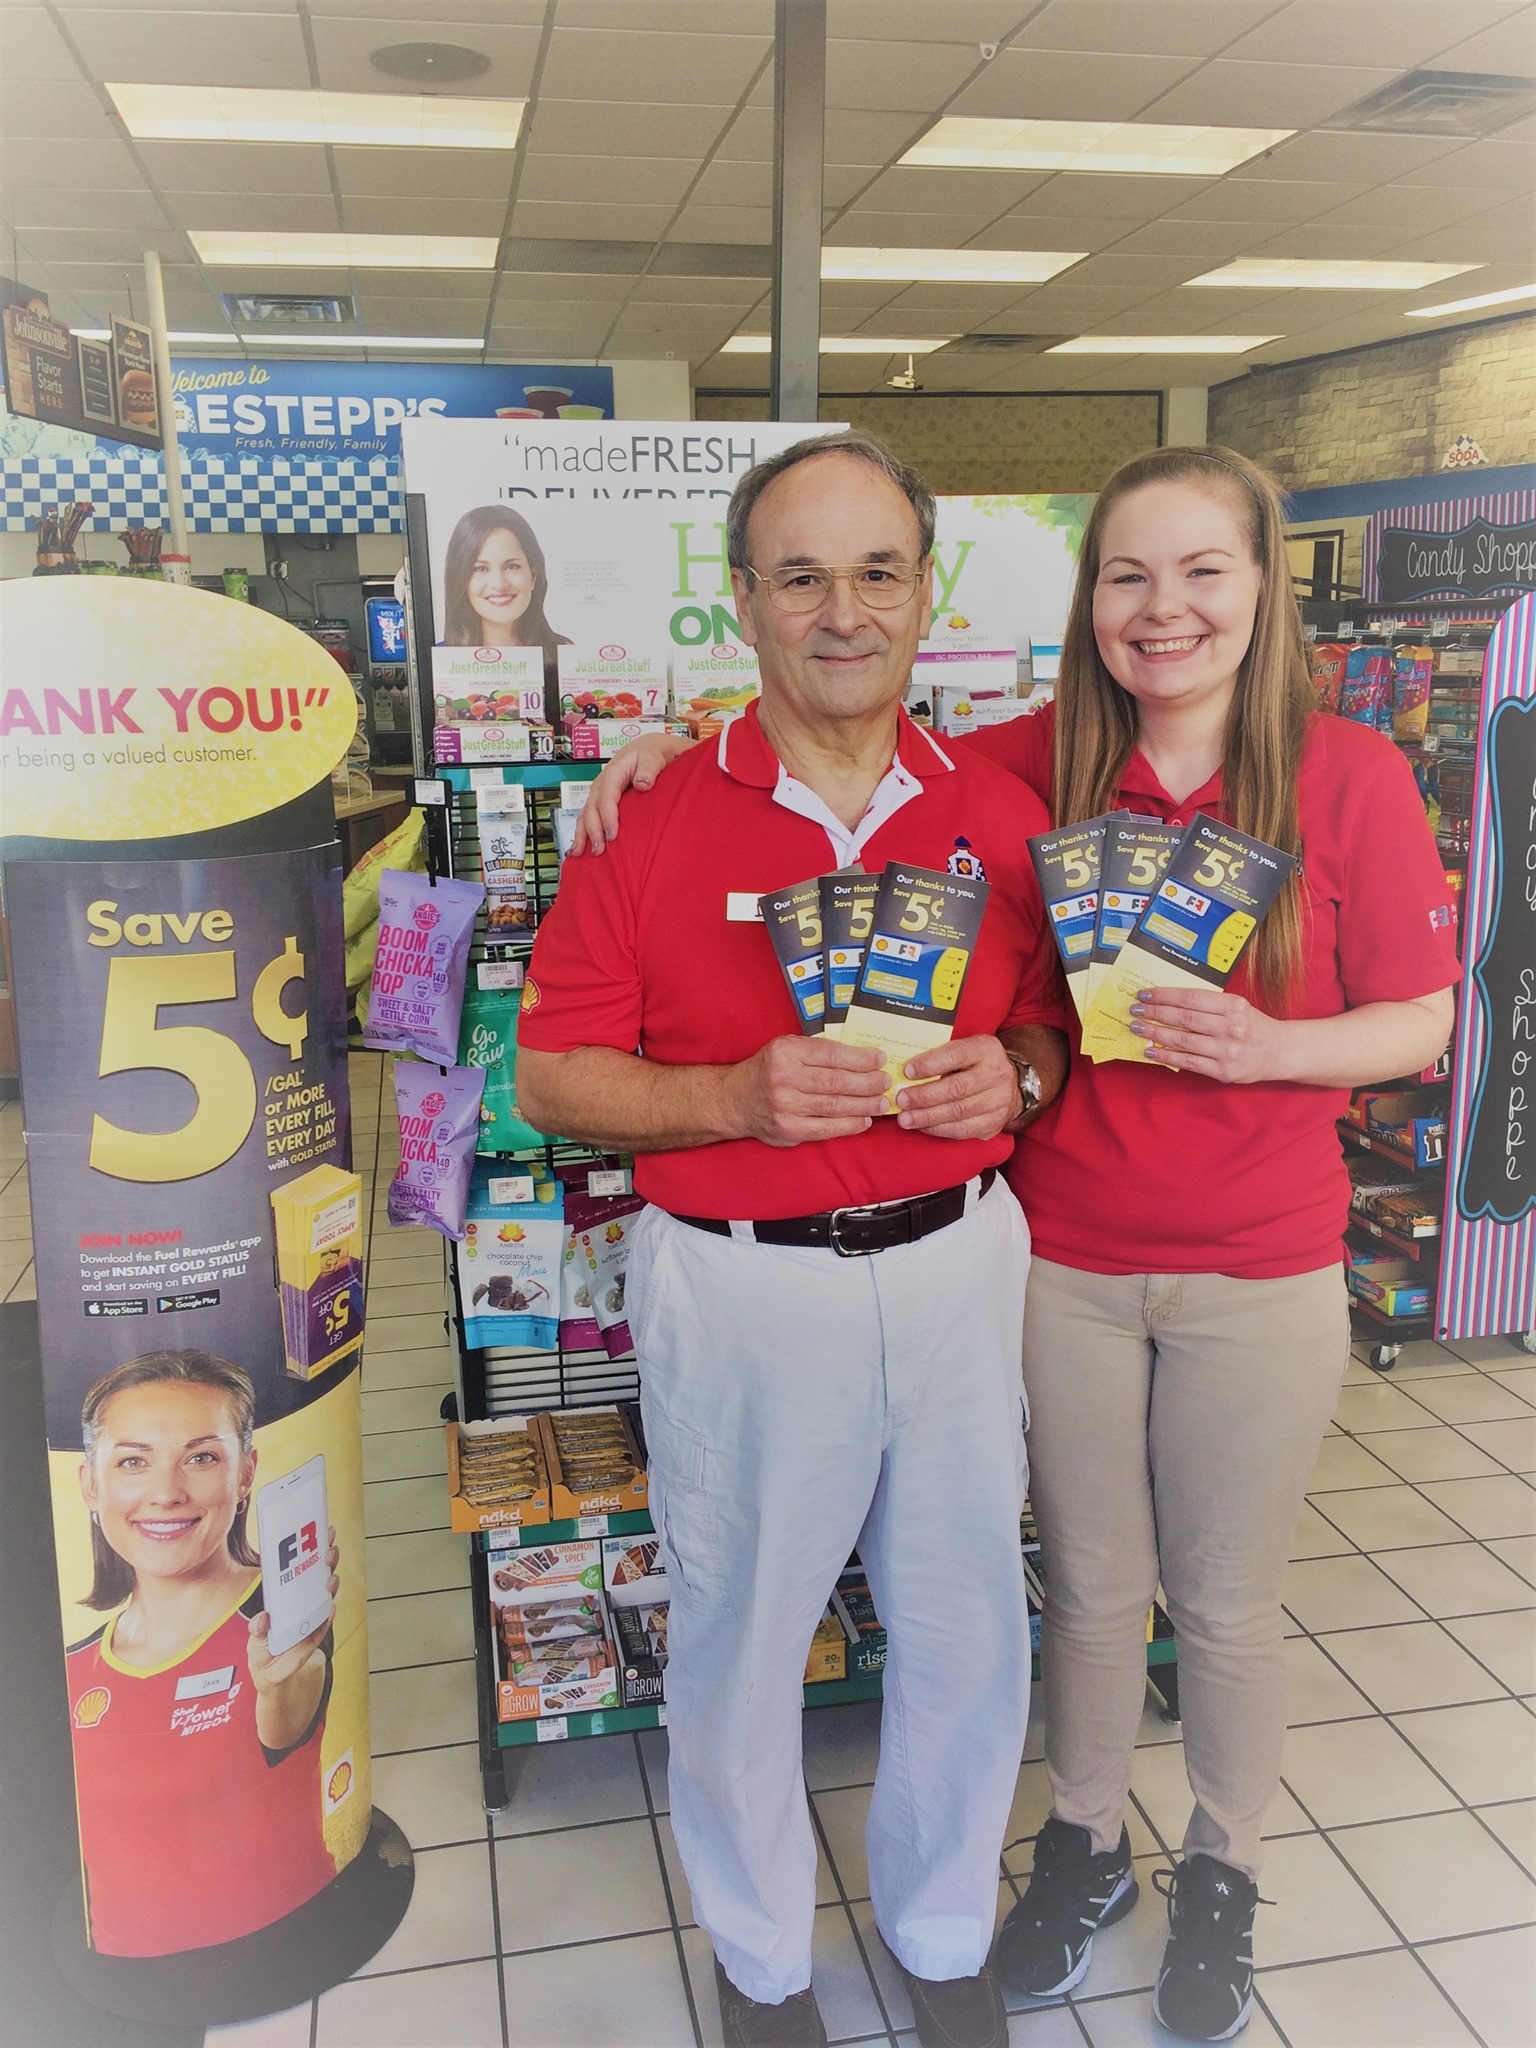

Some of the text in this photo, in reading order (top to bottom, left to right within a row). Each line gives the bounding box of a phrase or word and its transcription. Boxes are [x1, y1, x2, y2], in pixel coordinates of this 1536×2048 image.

[13, 314, 67, 353] Johnsonville
[36, 356, 62, 378] Flavor
[248, 364, 271, 385] to
[37, 373, 63, 395] Starts
[39, 393, 64, 410] HERE
[235, 437, 388, 451] Fresh, Friendly, Family
[1448, 448, 1480, 464] SODA
[1407, 538, 1467, 584] Candy
[947, 652, 992, 661] PROTEIN BAR
[523, 692, 541, 710] 10
[646, 689, 658, 707] 7
[535, 736, 554, 755] 10
[18, 744, 257, 771] being a valued customer.
[1040, 830, 1099, 852] Our thanks to
[1118, 831, 1180, 845] Our thanks to
[1193, 839, 1212, 852] Save
[1116, 845, 1135, 853] Save
[1200, 826, 1279, 870] Our thanks to you.
[485, 858, 524, 872] OLOMOMO
[1044, 855, 1062, 865] Save
[487, 877, 525, 885] CASHEWS
[833, 885, 852, 895] Our
[896, 874, 976, 900] Our thanks to you.
[893, 888, 911, 898] Save
[773, 900, 792, 911] Our
[834, 900, 852, 908] Save
[86, 900, 234, 947] Save
[778, 913, 796, 924] Save
[378, 925, 429, 953] BOOM
[374, 947, 435, 978] CHICKA
[371, 971, 404, 995] POP
[432, 972, 446, 983] 140
[377, 997, 437, 1016] SWEET & SALTY
[380, 1008, 430, 1026] KETTLE CORN
[472, 1023, 498, 1051] Go
[467, 1043, 505, 1069] Raw
[265, 1083, 325, 1116] or MORE
[265, 1100, 336, 1137] EVERY FILL,
[266, 1117, 337, 1157] EVERY DAY
[267, 1137, 337, 1172] with GOLD STATUS
[436, 1158, 450, 1168] 140
[79, 1229, 183, 1248] JOIN NOW!
[315, 1221, 356, 1248] TODAY APPLY
[80, 1252, 133, 1264] Download
[135, 1252, 152, 1262] the
[154, 1248, 179, 1261] Fuel
[239, 1235, 262, 1249] app
[525, 1253, 543, 1261] chip
[81, 1250, 250, 1280] to get INSTANT GOLD STATUS
[499, 1259, 531, 1267] coconut
[515, 1264, 547, 1279] Minis
[82, 1264, 247, 1292] and start saving on EVERY FILL!
[103, 1306, 144, 1316] App Store
[175, 1297, 217, 1310] Google Play
[318, 1300, 333, 1317] OFF
[328, 1331, 343, 1346] GET
[554, 1541, 595, 1554] CINNAMON
[564, 1553, 586, 1563] SPICE
[280, 1553, 319, 1586] FUEL REWARDS
[584, 1681, 611, 1690] CINNAMON
[632, 1677, 662, 1696] GROW
[172, 1704, 199, 1717] Shell
[509, 1693, 539, 1712] GROW
